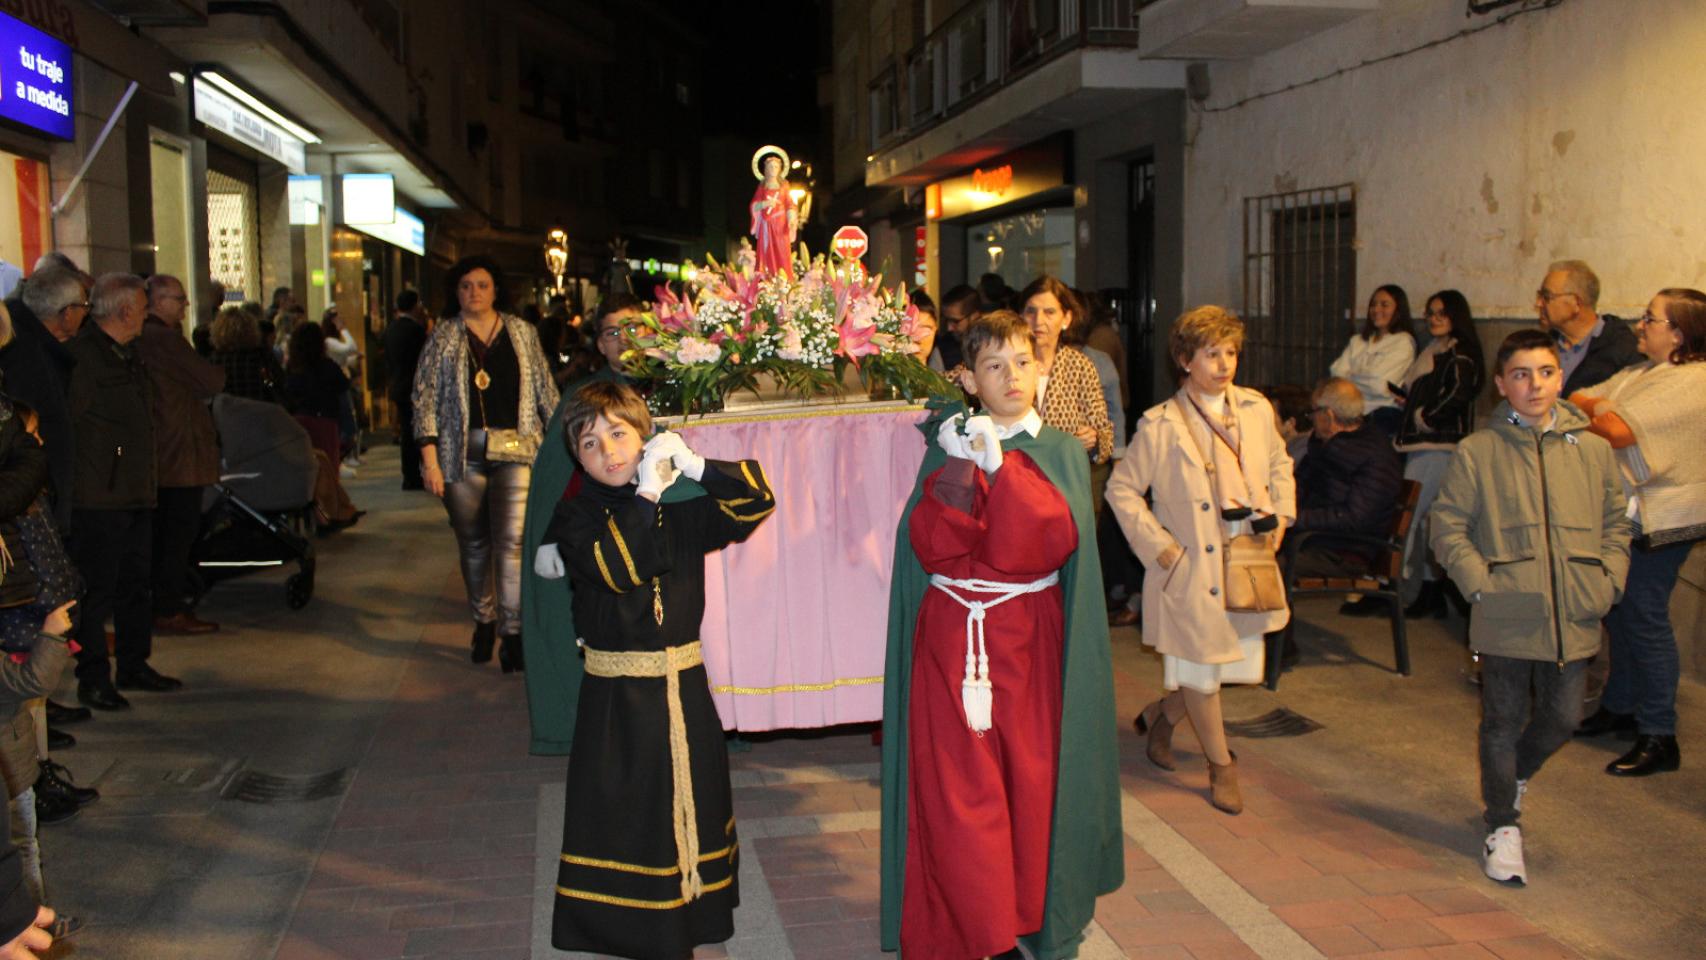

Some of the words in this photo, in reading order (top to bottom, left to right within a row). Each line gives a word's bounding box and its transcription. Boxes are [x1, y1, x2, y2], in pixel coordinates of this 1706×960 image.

[19, 46, 35, 71] tu
[36, 53, 64, 84] traje
[16, 81, 26, 99] a
[27, 85, 69, 117] medida
[837, 238, 865, 249] STOP
